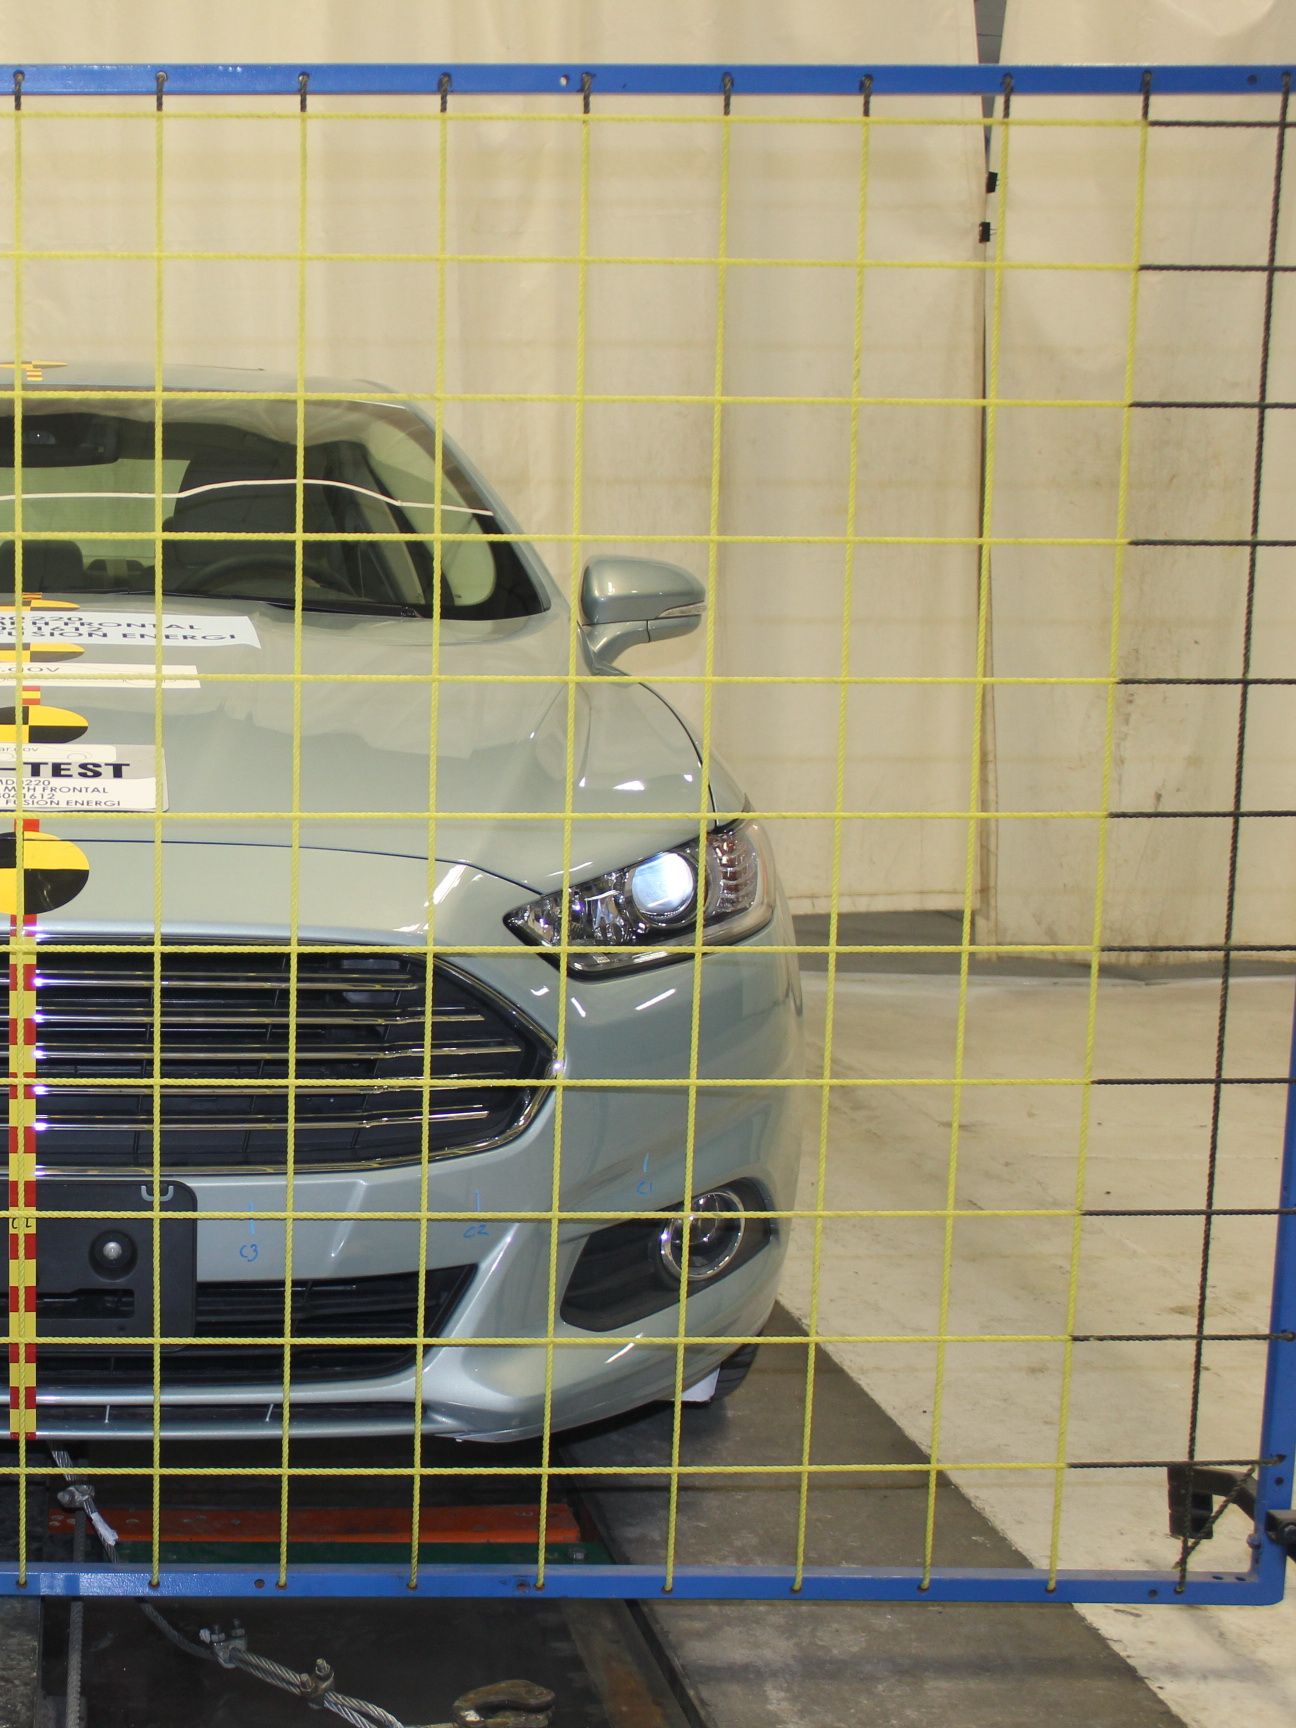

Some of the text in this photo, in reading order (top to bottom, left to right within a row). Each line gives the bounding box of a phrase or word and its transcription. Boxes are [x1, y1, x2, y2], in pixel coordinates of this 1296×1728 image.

[122, 633, 236, 641] ENERGI
[42, 786, 109, 794] FRONTAL
[636, 1180, 654, 1195] C1
[462, 1223, 490, 1239] C2
[238, 1243, 259, 1262] C3
